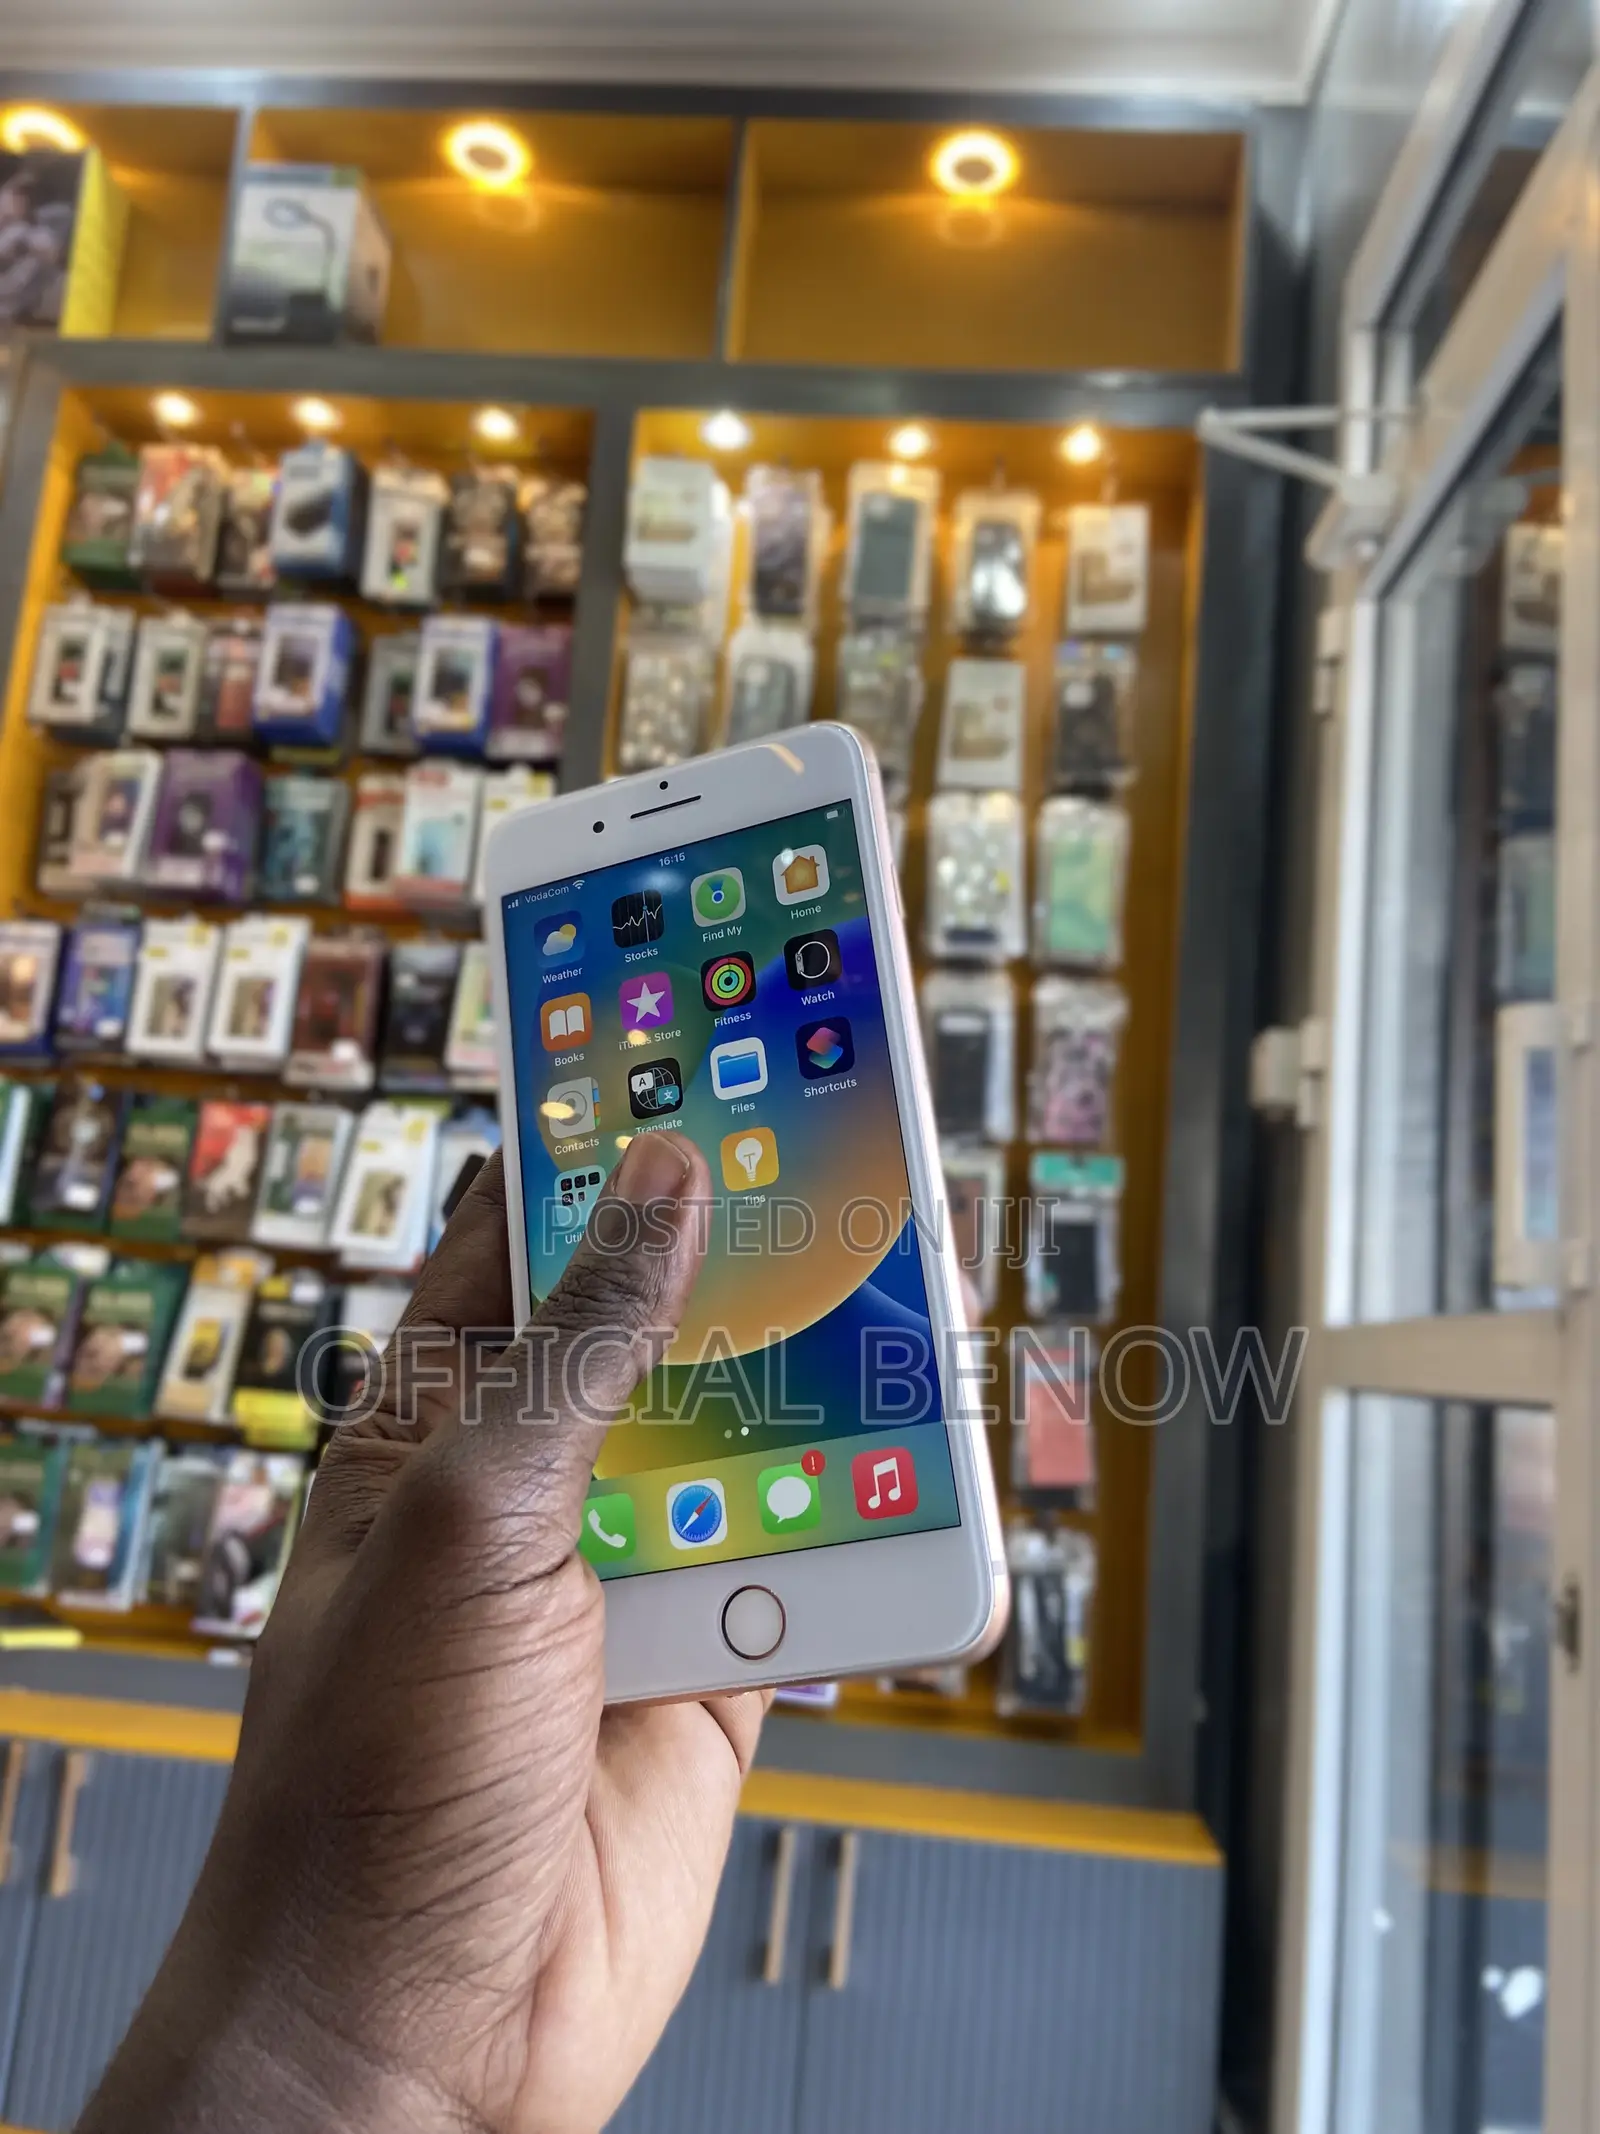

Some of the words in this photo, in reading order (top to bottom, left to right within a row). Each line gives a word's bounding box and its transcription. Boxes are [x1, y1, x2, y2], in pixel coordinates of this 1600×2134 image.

[659, 853, 686, 867] 16:15
[525, 885, 569, 904] VodaCom
[791, 904, 821, 919] Home
[702, 927, 724, 942] Find
[726, 924, 742, 937] My
[625, 947, 658, 963] Stocks
[542, 967, 583, 984] Weather
[801, 990, 835, 1006] Watch
[714, 1011, 751, 1027] Fitness
[654, 1029, 682, 1042] Store
[554, 1051, 585, 1066] Books
[804, 1078, 857, 1097] Shortcuts
[731, 1101, 756, 1114] Files
[555, 1137, 600, 1154] Contacts
[743, 1194, 766, 1207] Tips
